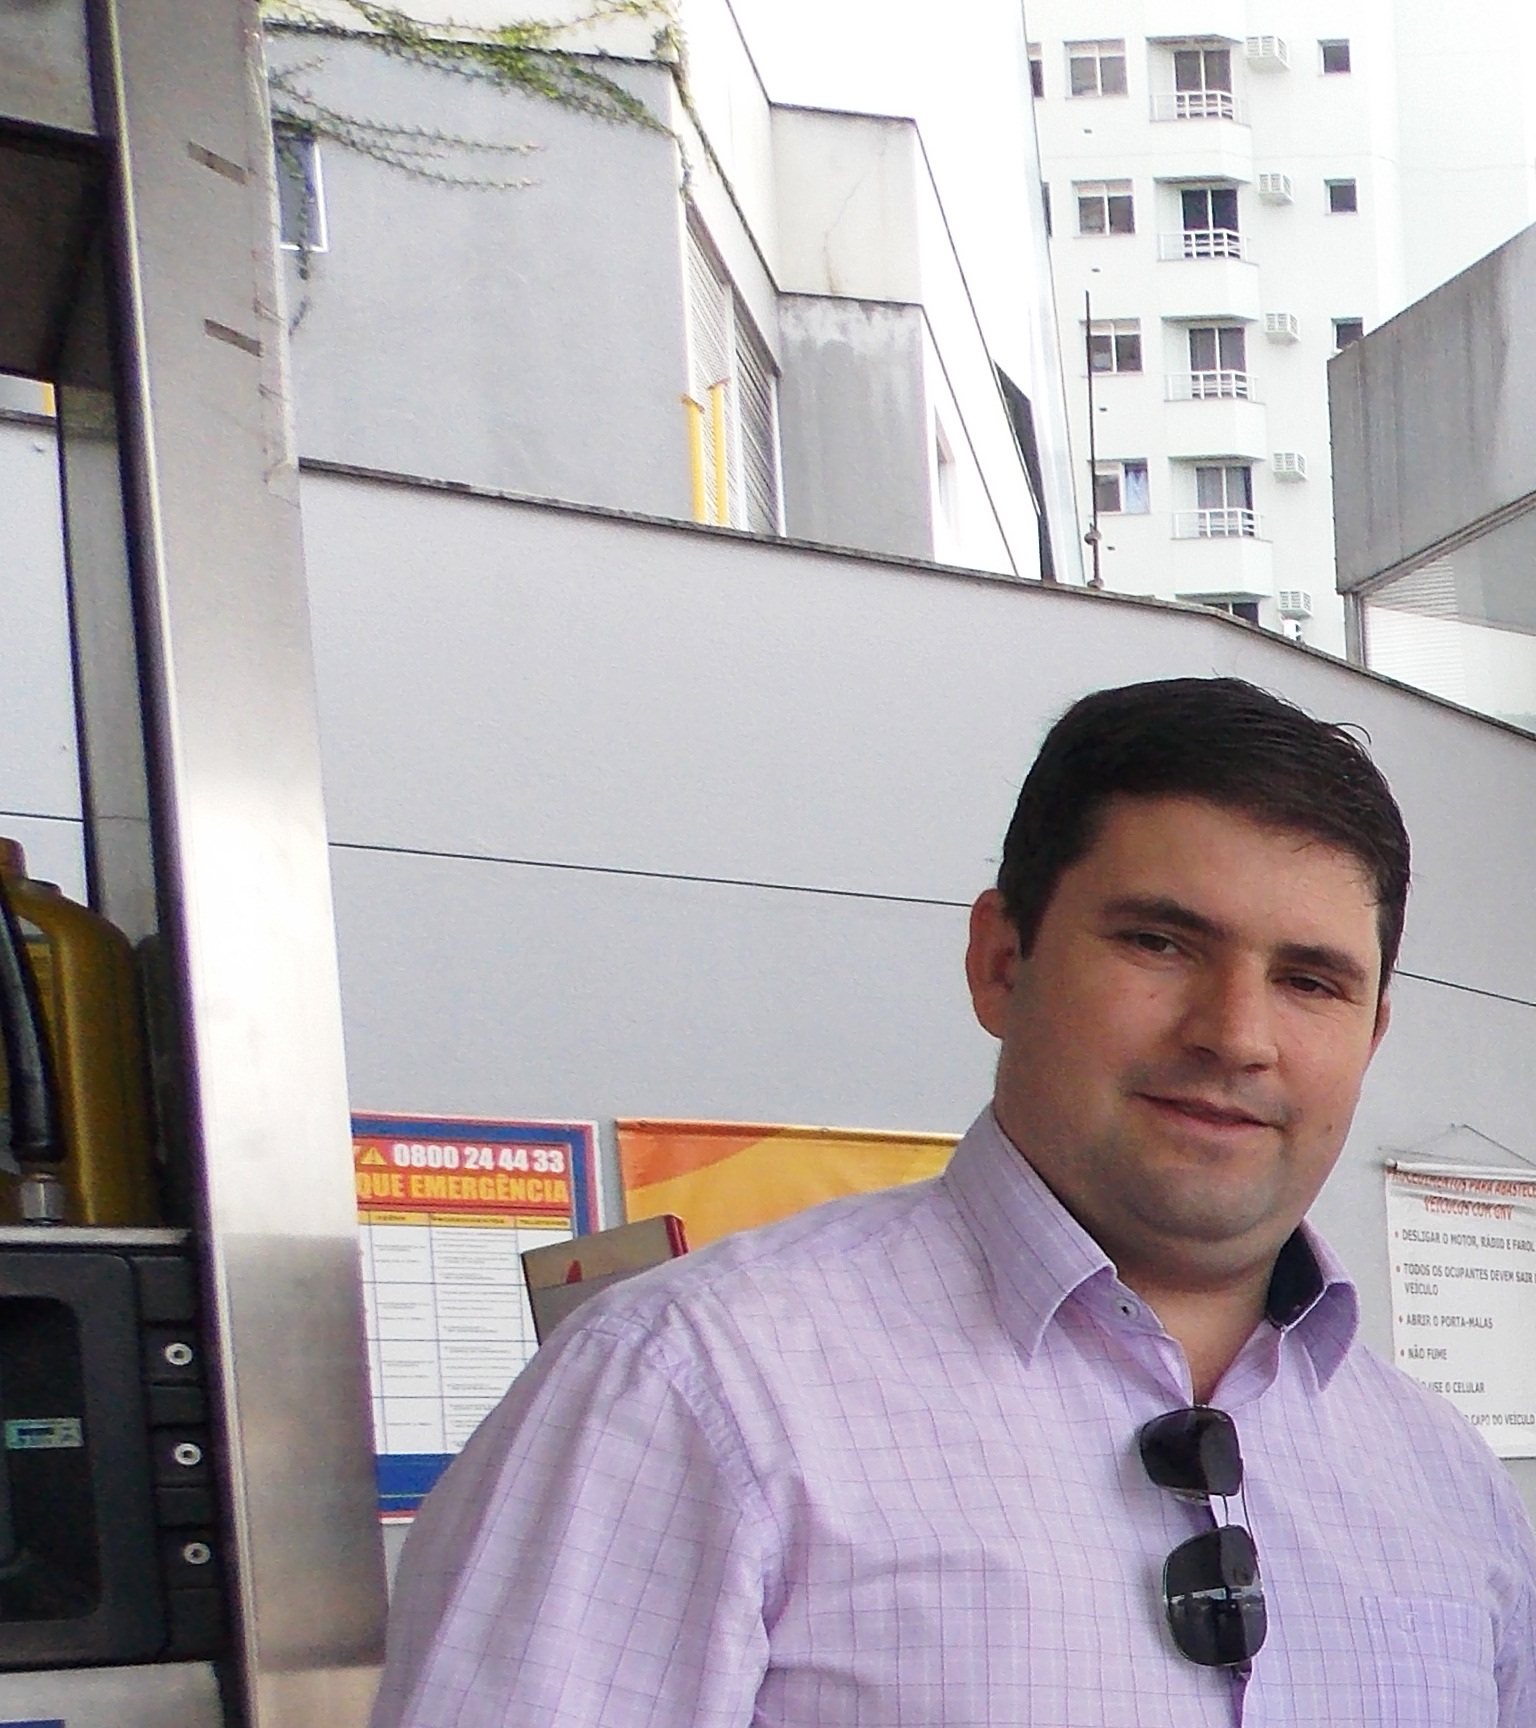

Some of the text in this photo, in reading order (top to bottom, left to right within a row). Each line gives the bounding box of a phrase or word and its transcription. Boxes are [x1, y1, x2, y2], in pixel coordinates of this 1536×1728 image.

[392, 1143, 567, 1174] 0800 24 44 33
[409, 1173, 570, 1204] EMERGÊNCIA
[1402, 1228, 1441, 1244] DESLIGAR
[1450, 1234, 1479, 1249] MOTOR,
[1481, 1234, 1506, 1249] RÁDIO
[1512, 1239, 1536, 1253] FAROL
[1403, 1262, 1431, 1277] TODOS
[1431, 1264, 1443, 1278] OS
[1444, 1266, 1489, 1281] OCUPANTES
[1490, 1270, 1515, 1283] DEVEM
[1515, 1271, 1533, 1284] SAIR
[1405, 1313, 1431, 1327] ABRIR
[1440, 1315, 1494, 1330] PORTA-MALAS
[1408, 1344, 1448, 1361] NÃO FUME
[1452, 1381, 1486, 1395] CELULAR
[1491, 1413, 1503, 1426] DO
